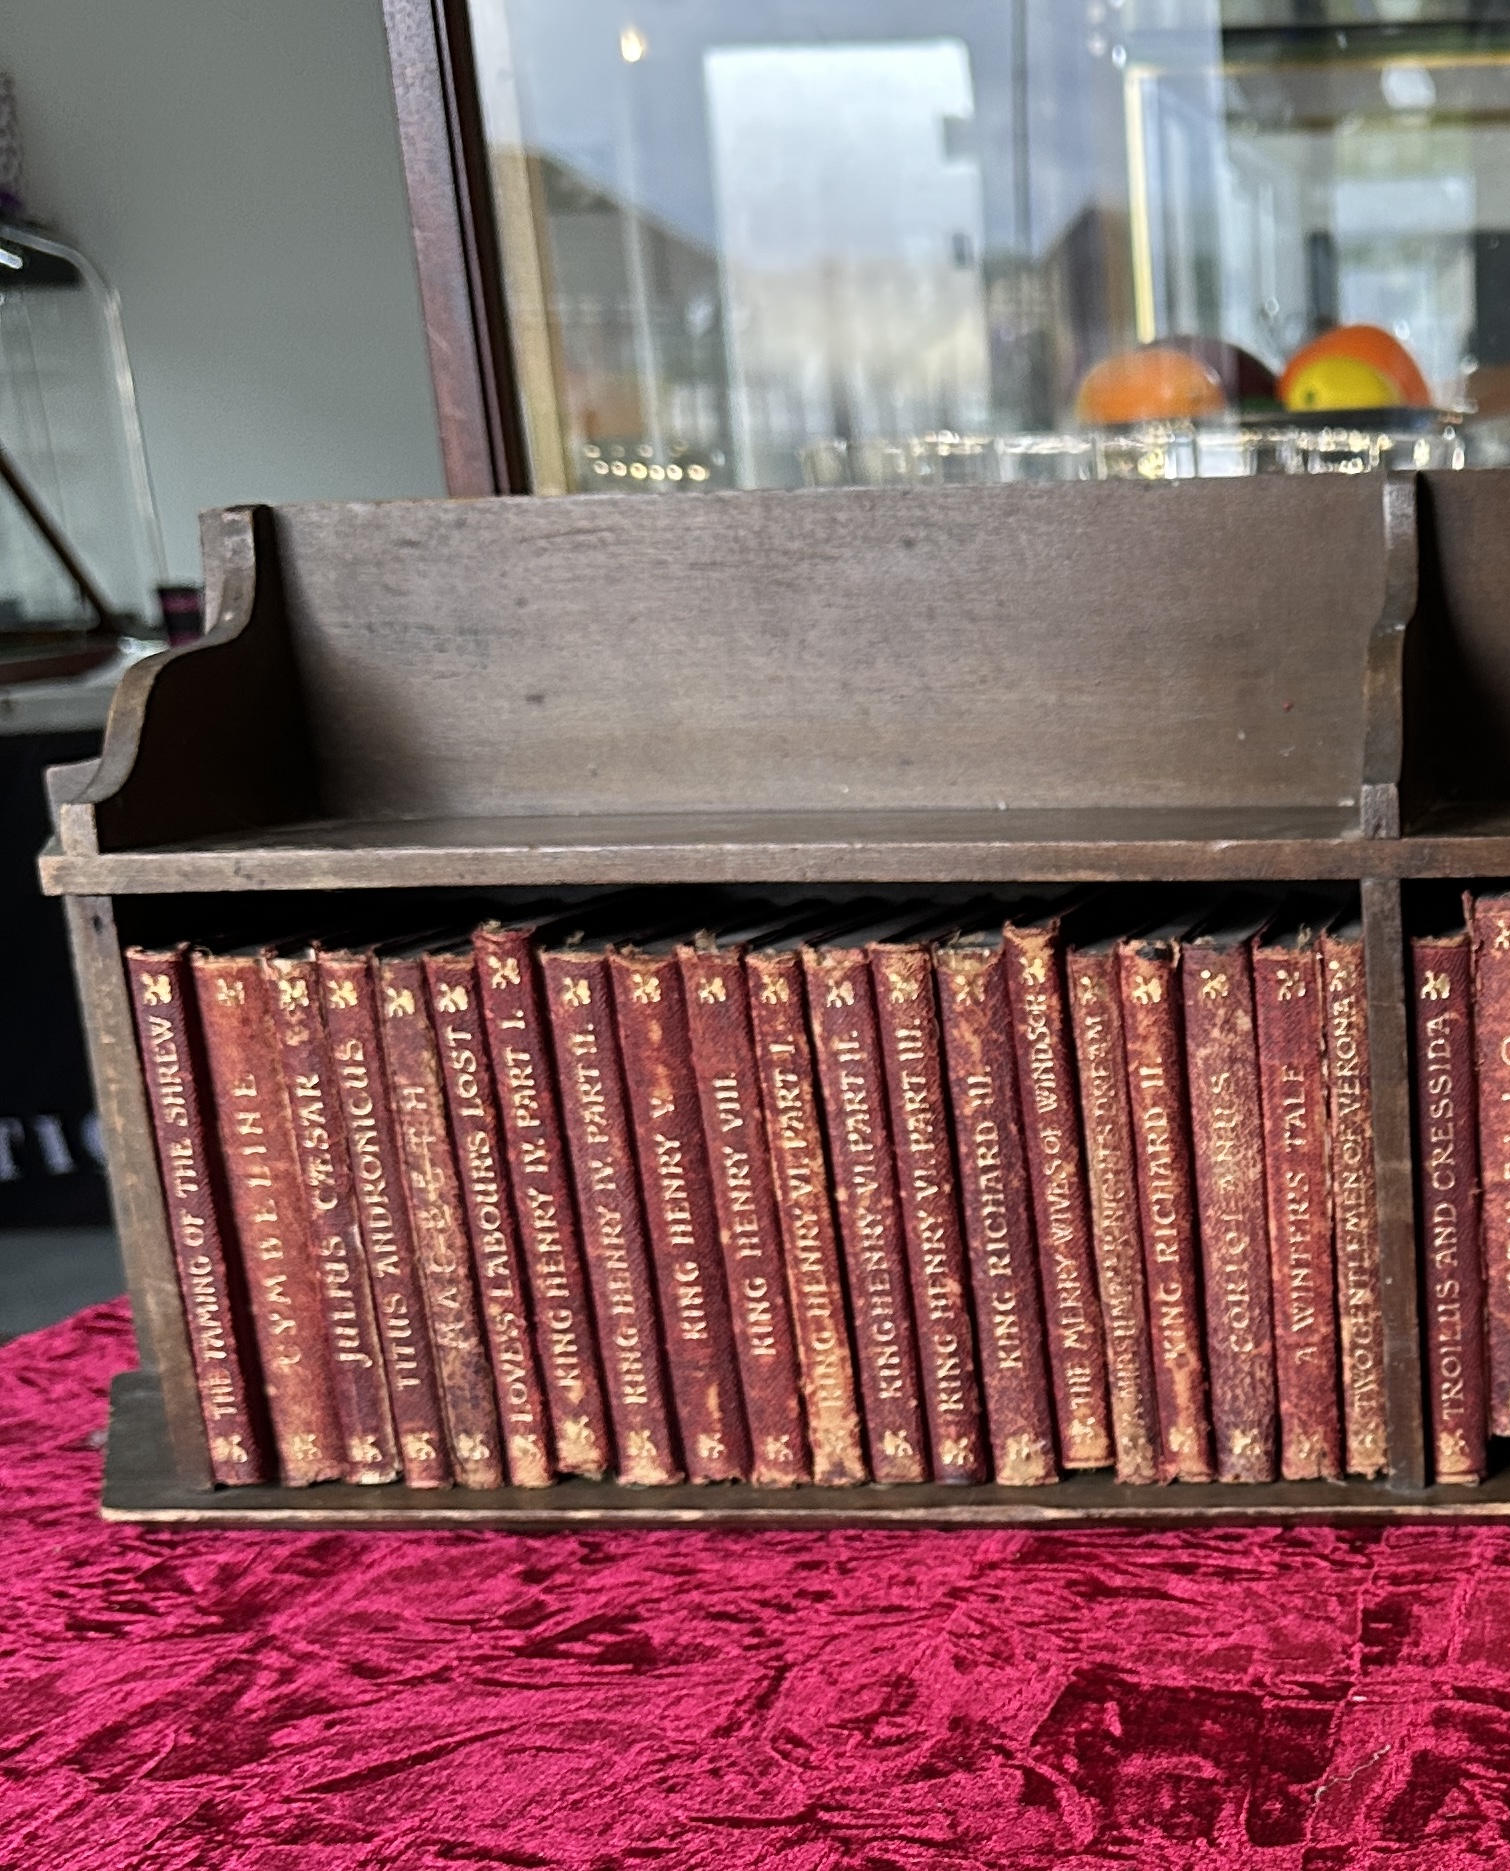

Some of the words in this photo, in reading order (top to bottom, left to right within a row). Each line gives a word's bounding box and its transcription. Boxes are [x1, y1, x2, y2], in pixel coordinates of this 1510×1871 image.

[500, 1009, 526, 1030] I.
[1024, 993, 1059, 1115] WINDSOR
[1331, 994, 1361, 1118] VERONA
[147, 1014, 189, 1128] SHREW
[446, 1025, 486, 1118] LOST
[505, 1046, 541, 1128] PART
[576, 1062, 610, 1144] PART
[773, 1067, 808, 1150] PART
[840, 1070, 874, 1153] PART
[901, 1070, 936, 1153] PART
[1281, 1064, 1307, 1153] TALE
[1426, 1011, 1456, 1192] CRESSIDA
[170, 1137, 199, 1199] THE
[333, 1037, 401, 1279] ANDRONICUS
[1039, 1126, 1063, 1155] OF
[1142, 1106, 1180, 1263] RICHARD
[1338, 1123, 1364, 1165] OF
[179, 1208, 205, 1247] OF
[232, 1072, 302, 1368] CYMBELINE
[403, 1085, 478, 1350] MACBETH
[653, 1132, 695, 1246] HENRY
[722, 1146, 763, 1258] HENRY
[974, 1120, 1014, 1278] RICHARD
[1043, 1158, 1075, 1248] WIVES
[526, 1187, 571, 1298] HENRY
[595, 1204, 636, 1316] HENRY
[790, 1206, 831, 1318] HENRY
[855, 1206, 895, 1317] HENRY
[916, 1209, 956, 1321] HENRY
[1340, 1169, 1374, 1346] GENTLEMEN
[1432, 1201, 1459, 1270] AND
[188, 1255, 227, 1361] TAMING
[321, 1235, 374, 1369] JULIUS
[382, 1292, 422, 1391] TITUS
[673, 1260, 709, 1340] KING
[743, 1276, 777, 1356] KING
[990, 1290, 1024, 1370] KING
[1054, 1252, 1090, 1352] MERRY
[1158, 1281, 1186, 1361] KING
[548, 1306, 582, 1388] KING
[613, 1325, 649, 1406] KING
[871, 1320, 903, 1400] KING
[934, 1333, 965, 1413] KING
[1065, 1359, 1092, 1411] THE
[1293, 1345, 1318, 1365] A
[1352, 1348, 1378, 1413] TWO
[1435, 1279, 1466, 1421] TROILUS
[206, 1367, 238, 1421] THE
